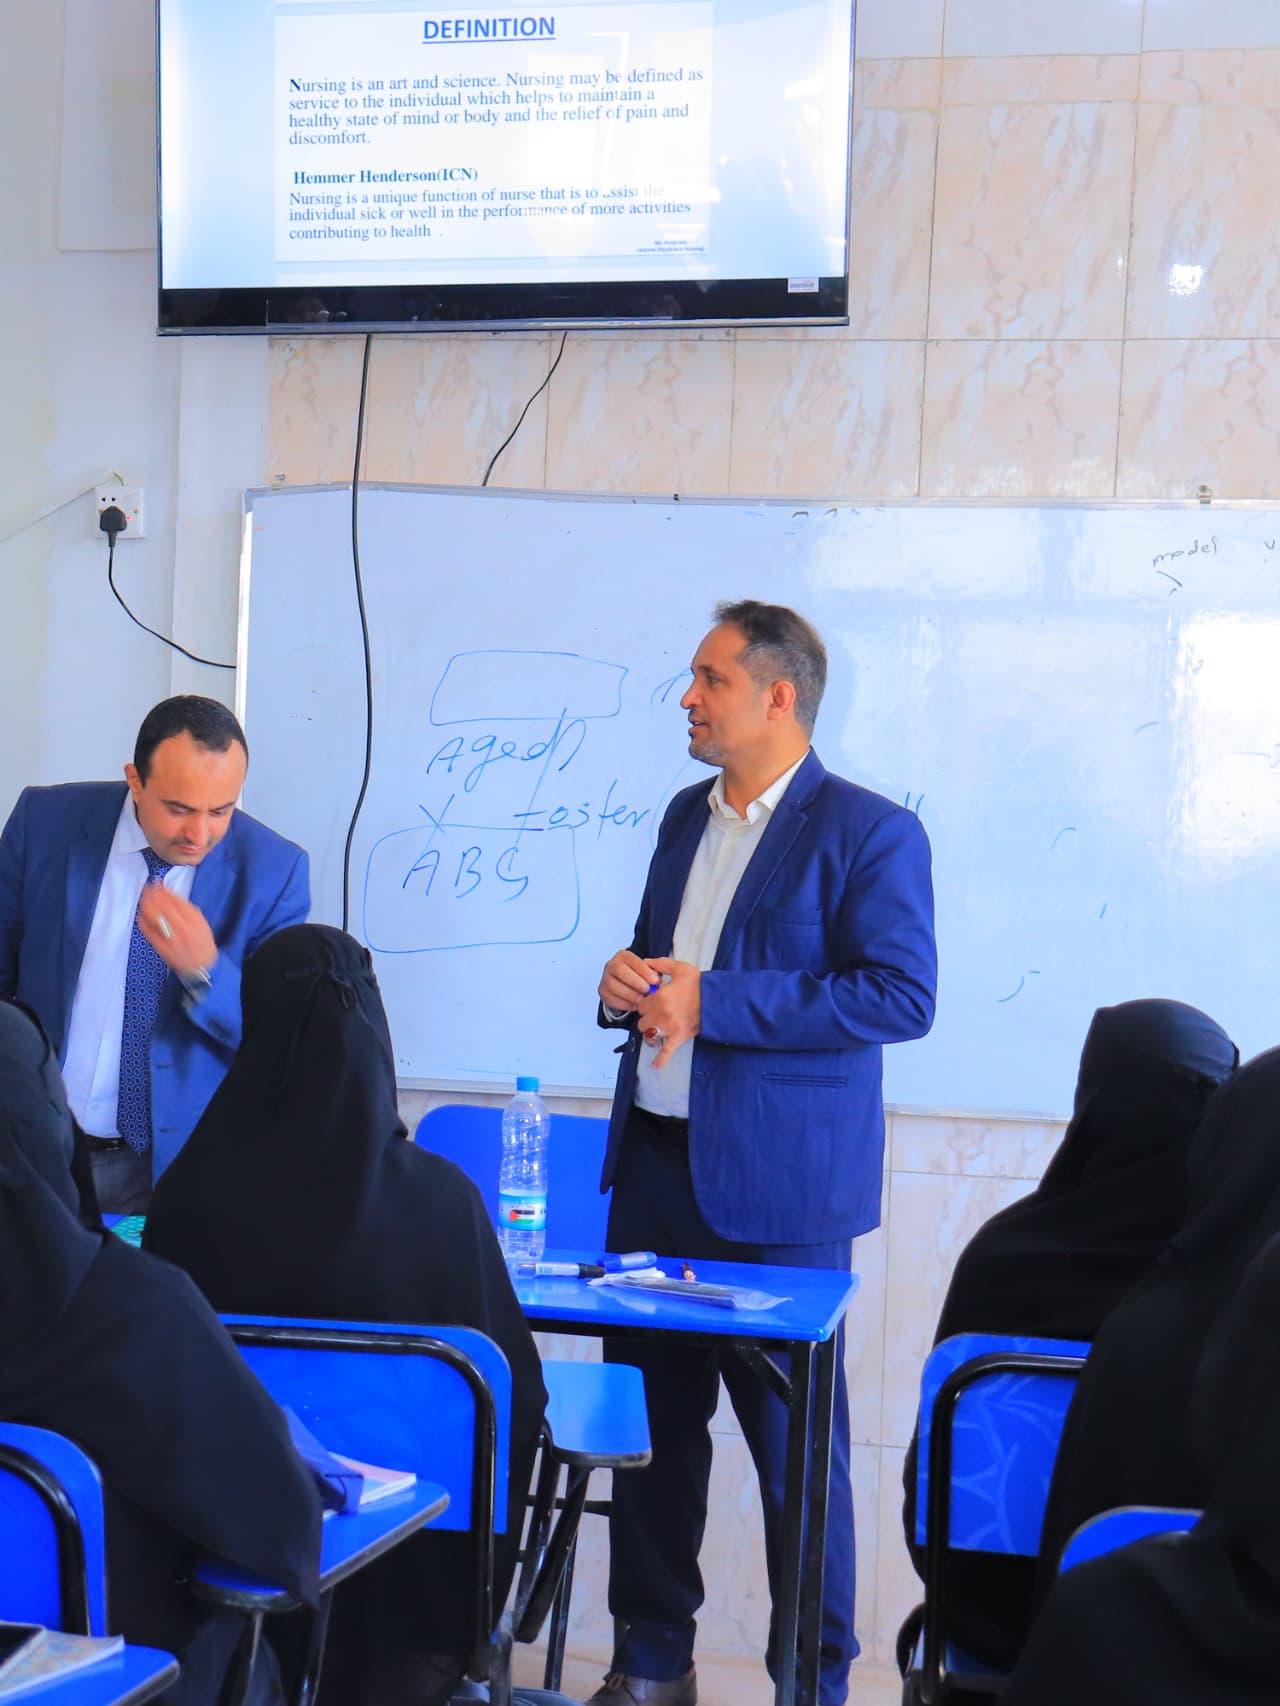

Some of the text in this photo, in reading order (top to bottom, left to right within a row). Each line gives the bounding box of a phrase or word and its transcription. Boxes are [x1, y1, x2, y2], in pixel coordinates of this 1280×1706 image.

[423, 17, 556, 41] DEFINITION
[289, 77, 347, 95] Nursing
[351, 77, 364, 92] is
[367, 79, 384, 91] an
[389, 78, 408, 90] art
[412, 75, 438, 90] and
[443, 74, 501, 89] science.
[506, 72, 564, 88] Nursing
[569, 73, 601, 88] may
[627, 67, 683, 83] defined
[688, 69, 704, 81] as
[289, 86, 655, 111] service to the individual which helps to maintain a
[289, 103, 689, 130] healthy state of mind or body and the relief of pain and
[289, 130, 371, 146] discomfort.
[293, 168, 478, 185] Hemmer Henderson(ICN)
[289, 191, 342, 208] Nursing
[346, 191, 357, 205] is
[361, 193, 369, 204] a
[373, 190, 418, 207] unique
[422, 189, 477, 203] function
[481, 188, 497, 201] of
[500, 189, 536, 201] nurse
[540, 187, 566, 200] that
[570, 186, 582, 200] is
[289, 199, 691, 222] individual sick or well in the performance of more activities
[289, 224, 432, 242] contributing to health
